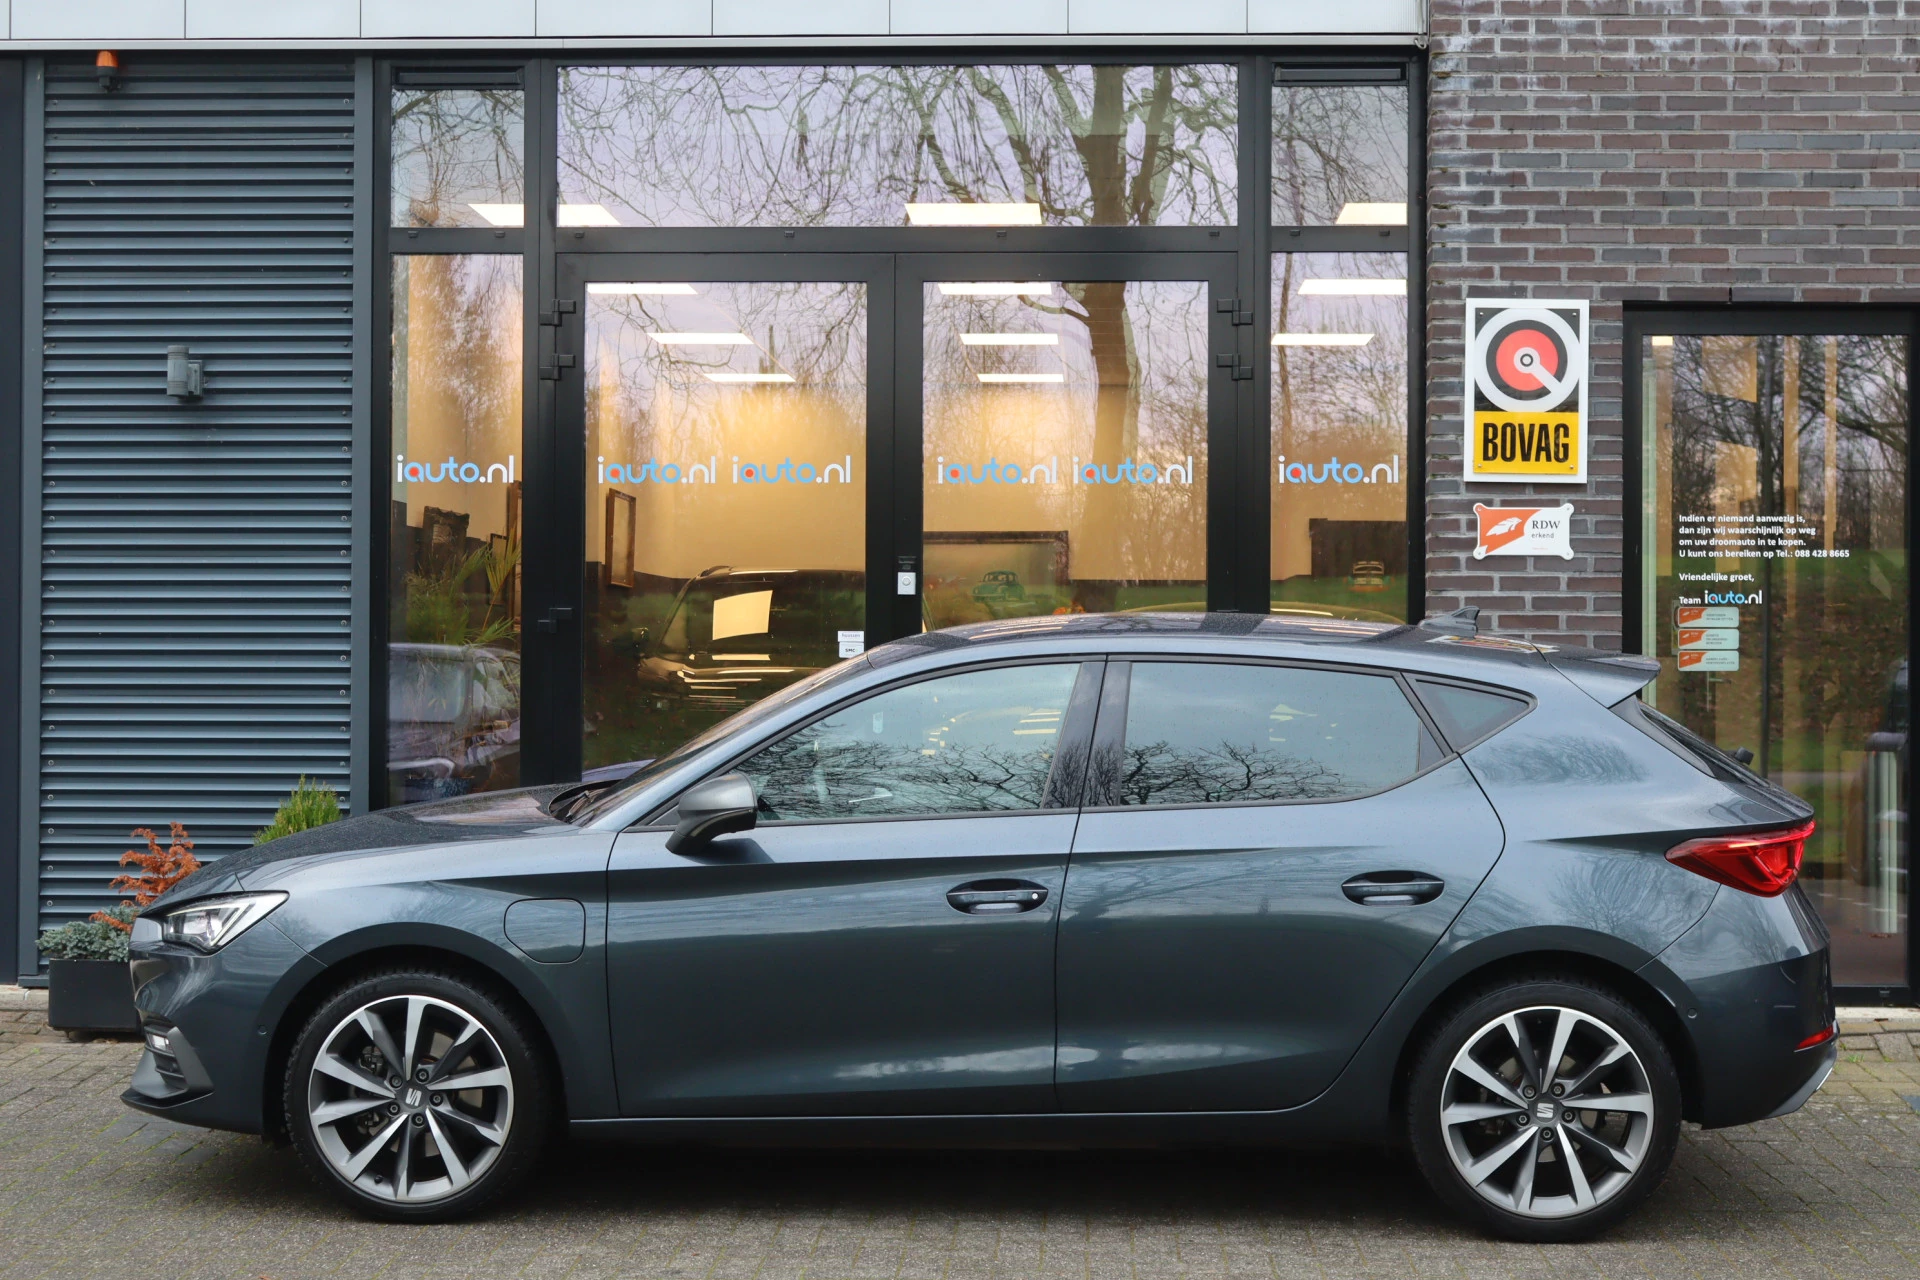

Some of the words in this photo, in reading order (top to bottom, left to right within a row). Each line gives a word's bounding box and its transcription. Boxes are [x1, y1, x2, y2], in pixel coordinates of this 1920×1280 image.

[1482, 422, 1570, 463] BOVAG
[397, 454, 514, 483] iauto.nl
[597, 455, 716, 484] iauto.nl
[732, 455, 851, 484] iauto.nl
[937, 456, 1057, 484] iauto.nl
[1073, 456, 1193, 484] iauto.nl
[1278, 455, 1399, 484] iauto.nl
[1532, 520, 1560, 529] RDW
[1679, 514, 1705, 523] Indien
[1717, 514, 1754, 523] niemand
[1756, 514, 1794, 524] aanwezig
[1796, 514, 1806, 524] is,
[1679, 526, 1694, 534] dan
[1696, 526, 1711, 536] zijn
[1712, 526, 1726, 536] wij
[1728, 526, 1784, 536] waarschijnlijk
[1785, 528, 1796, 536] op
[1799, 528, 1816, 536] weg
[1709, 538, 1756, 546] droomauto
[1757, 538, 1765, 546] in
[1767, 538, 1776, 546] te
[1778, 538, 1806, 548] kopen.
[1679, 550, 1686, 558] U
[1688, 550, 1707, 558] kunt
[1725, 550, 1761, 558] bereiken
[1763, 551, 1774, 559] op
[1776, 550, 1793, 558] Tel.:
[1795, 550, 1810, 558] 088
[1812, 550, 1827, 558] 428
[1829, 550, 1850, 558] 8665
[1679, 573, 1728, 583] Vriendelijke
[1730, 574, 1755, 583] groet,
[1679, 596, 1701, 604] Team
[1704, 590, 1763, 604] iauto.nl
